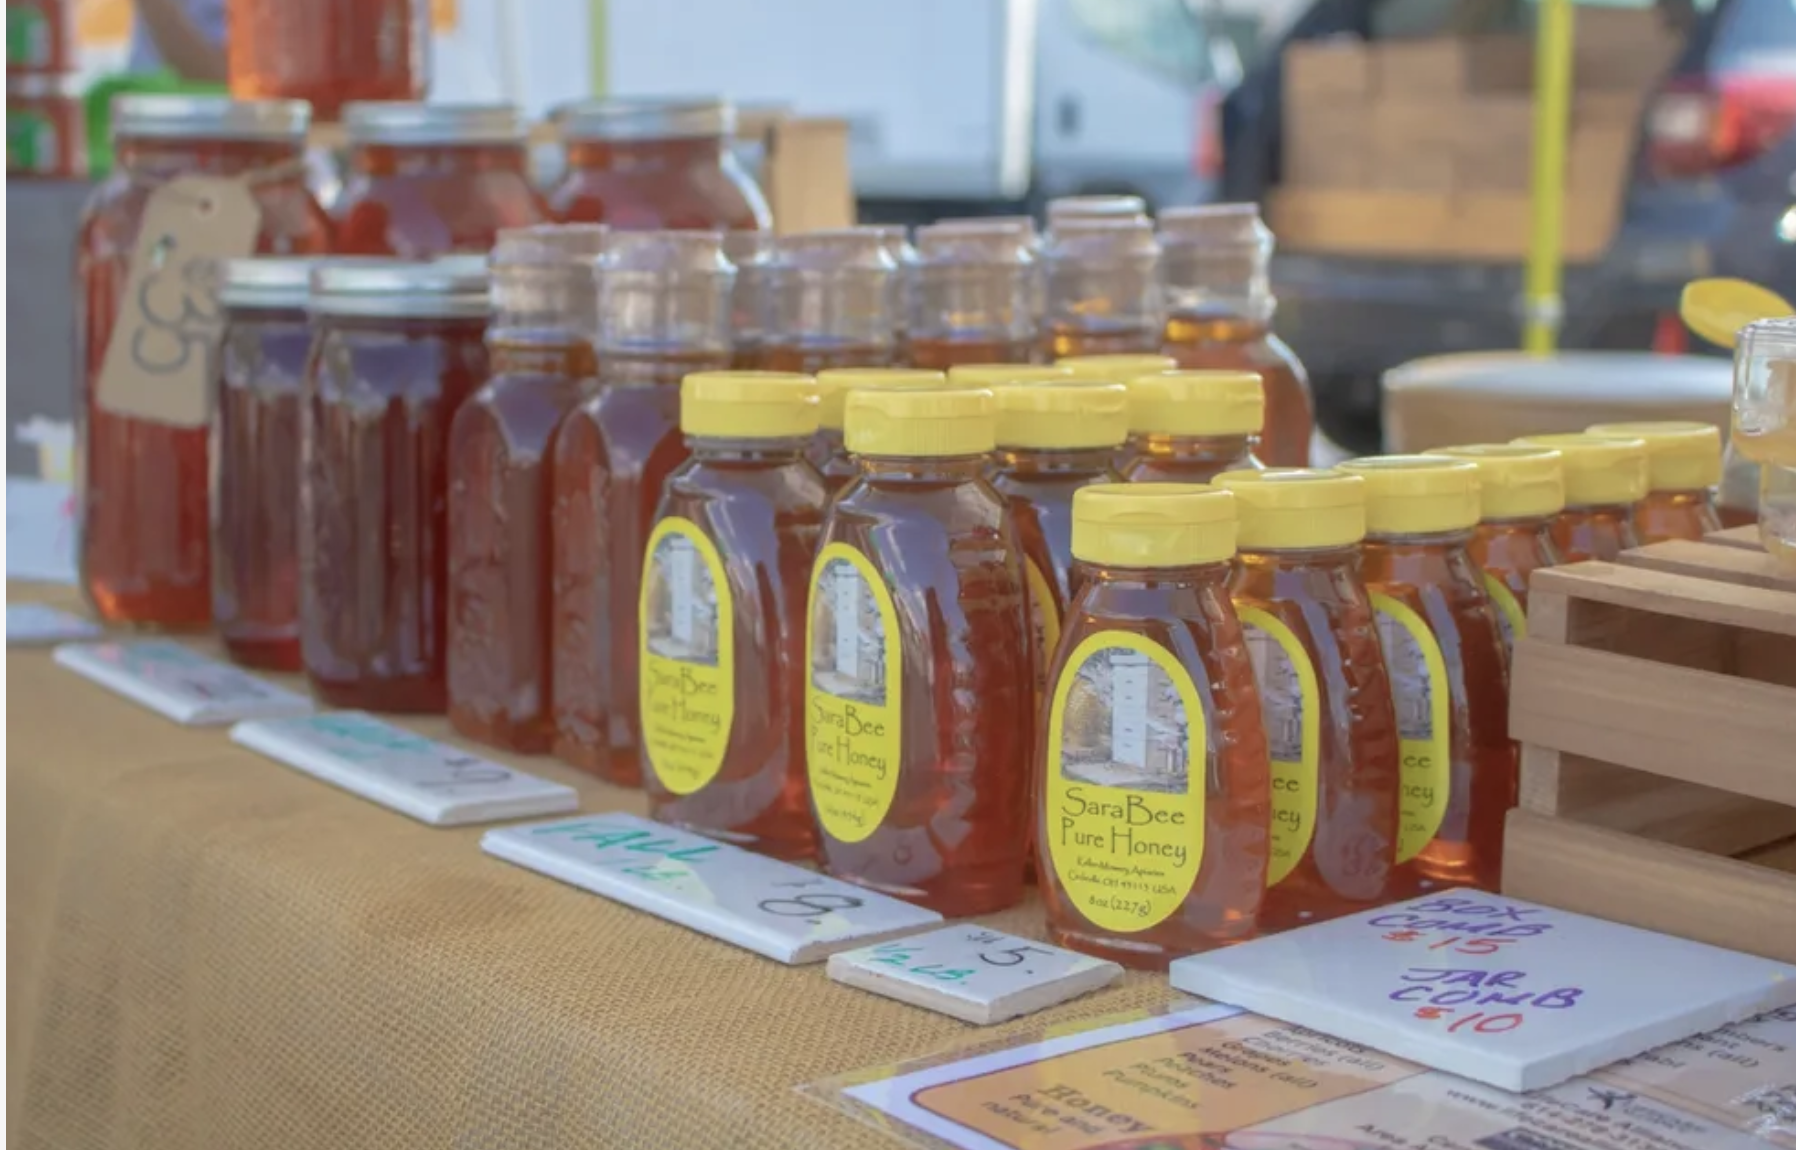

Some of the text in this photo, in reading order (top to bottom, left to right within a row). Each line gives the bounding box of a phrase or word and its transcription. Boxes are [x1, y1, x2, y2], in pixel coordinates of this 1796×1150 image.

[812, 696, 885, 737] SaraBee
[836, 735, 886, 780] Honey
[1061, 787, 1185, 826] SaraBee
[1061, 816, 1105, 848] Pure
[1110, 825, 1187, 868] Honey
[1406, 898, 1544, 921] BOX
[1368, 914, 1553, 936] COMB
[1381, 930, 1518, 955] $15
[1400, 967, 1527, 988] JAR
[1389, 985, 1584, 1009] COMB
[1414, 1006, 1524, 1033] $10
[1036, 1083, 1155, 1133] Honey
